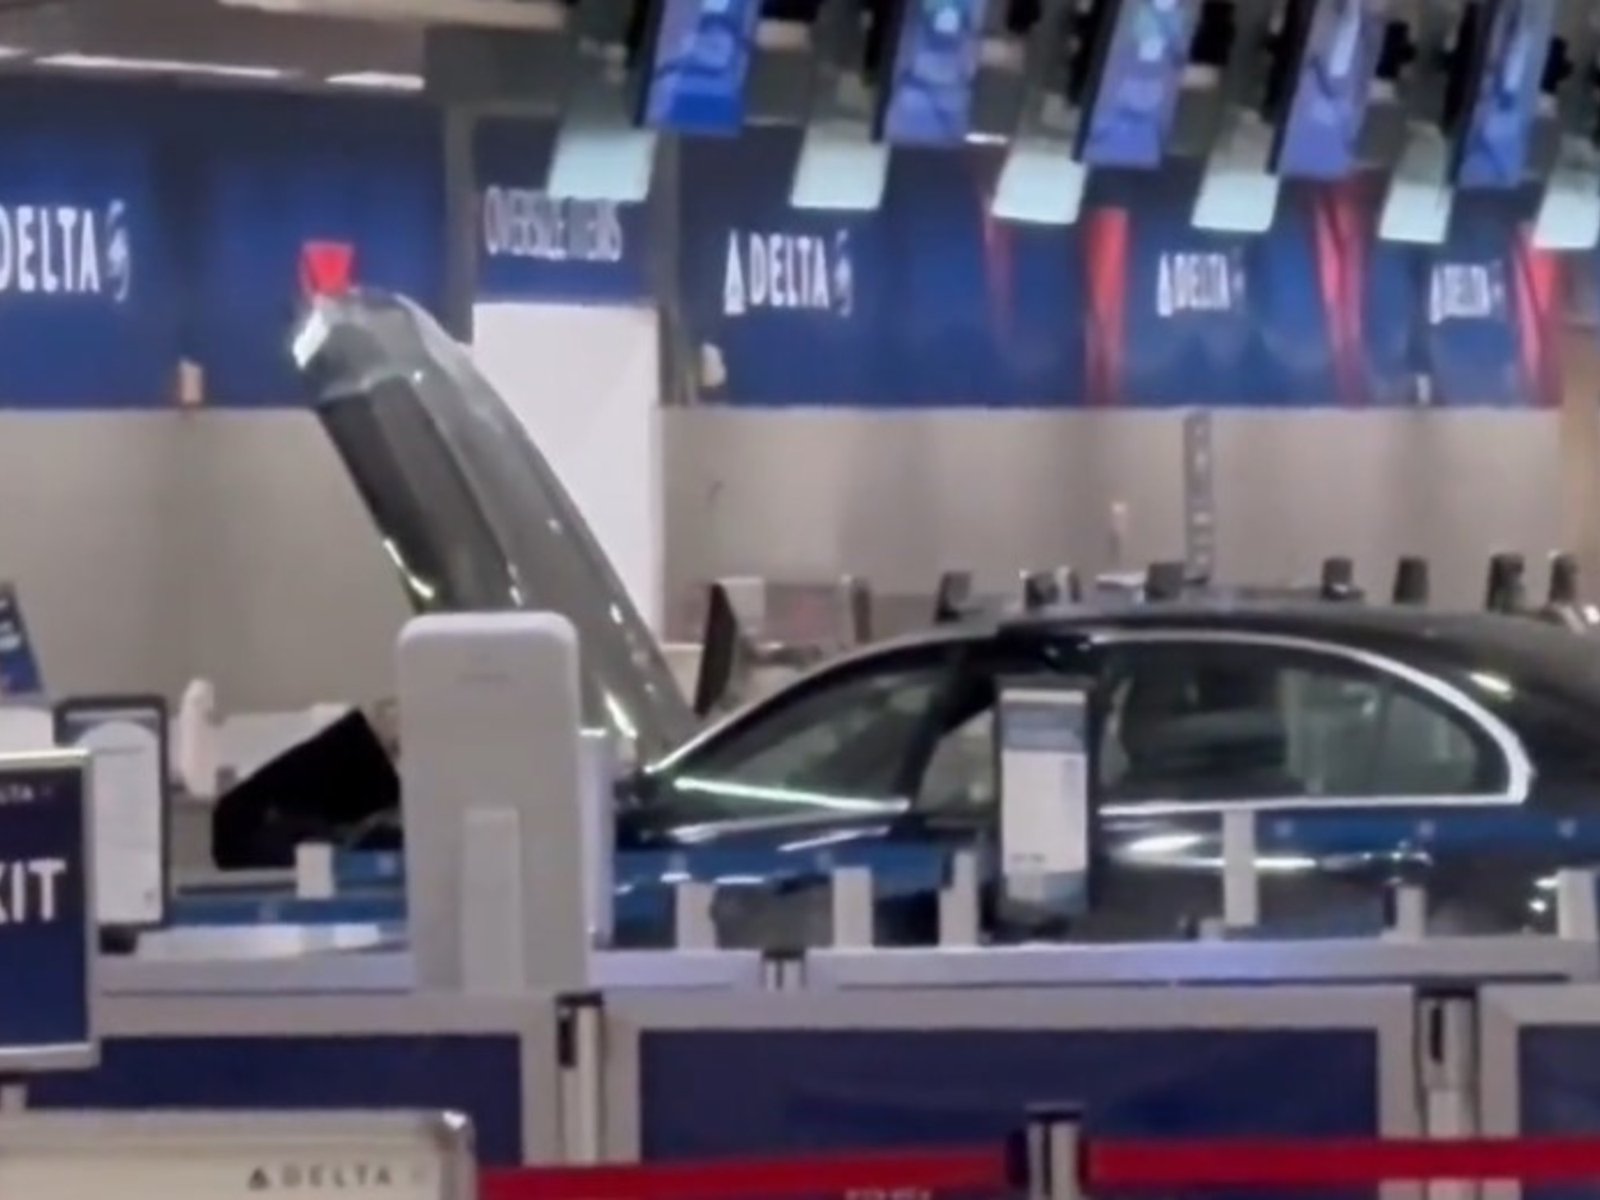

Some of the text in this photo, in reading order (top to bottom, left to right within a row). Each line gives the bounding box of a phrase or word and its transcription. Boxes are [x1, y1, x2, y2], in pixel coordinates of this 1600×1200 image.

[750, 232, 830, 309] DELTA
[1173, 251, 1230, 310] DELTA
[1443, 263, 1489, 318] DELTA
[281, 1164, 392, 1188] DELTA
